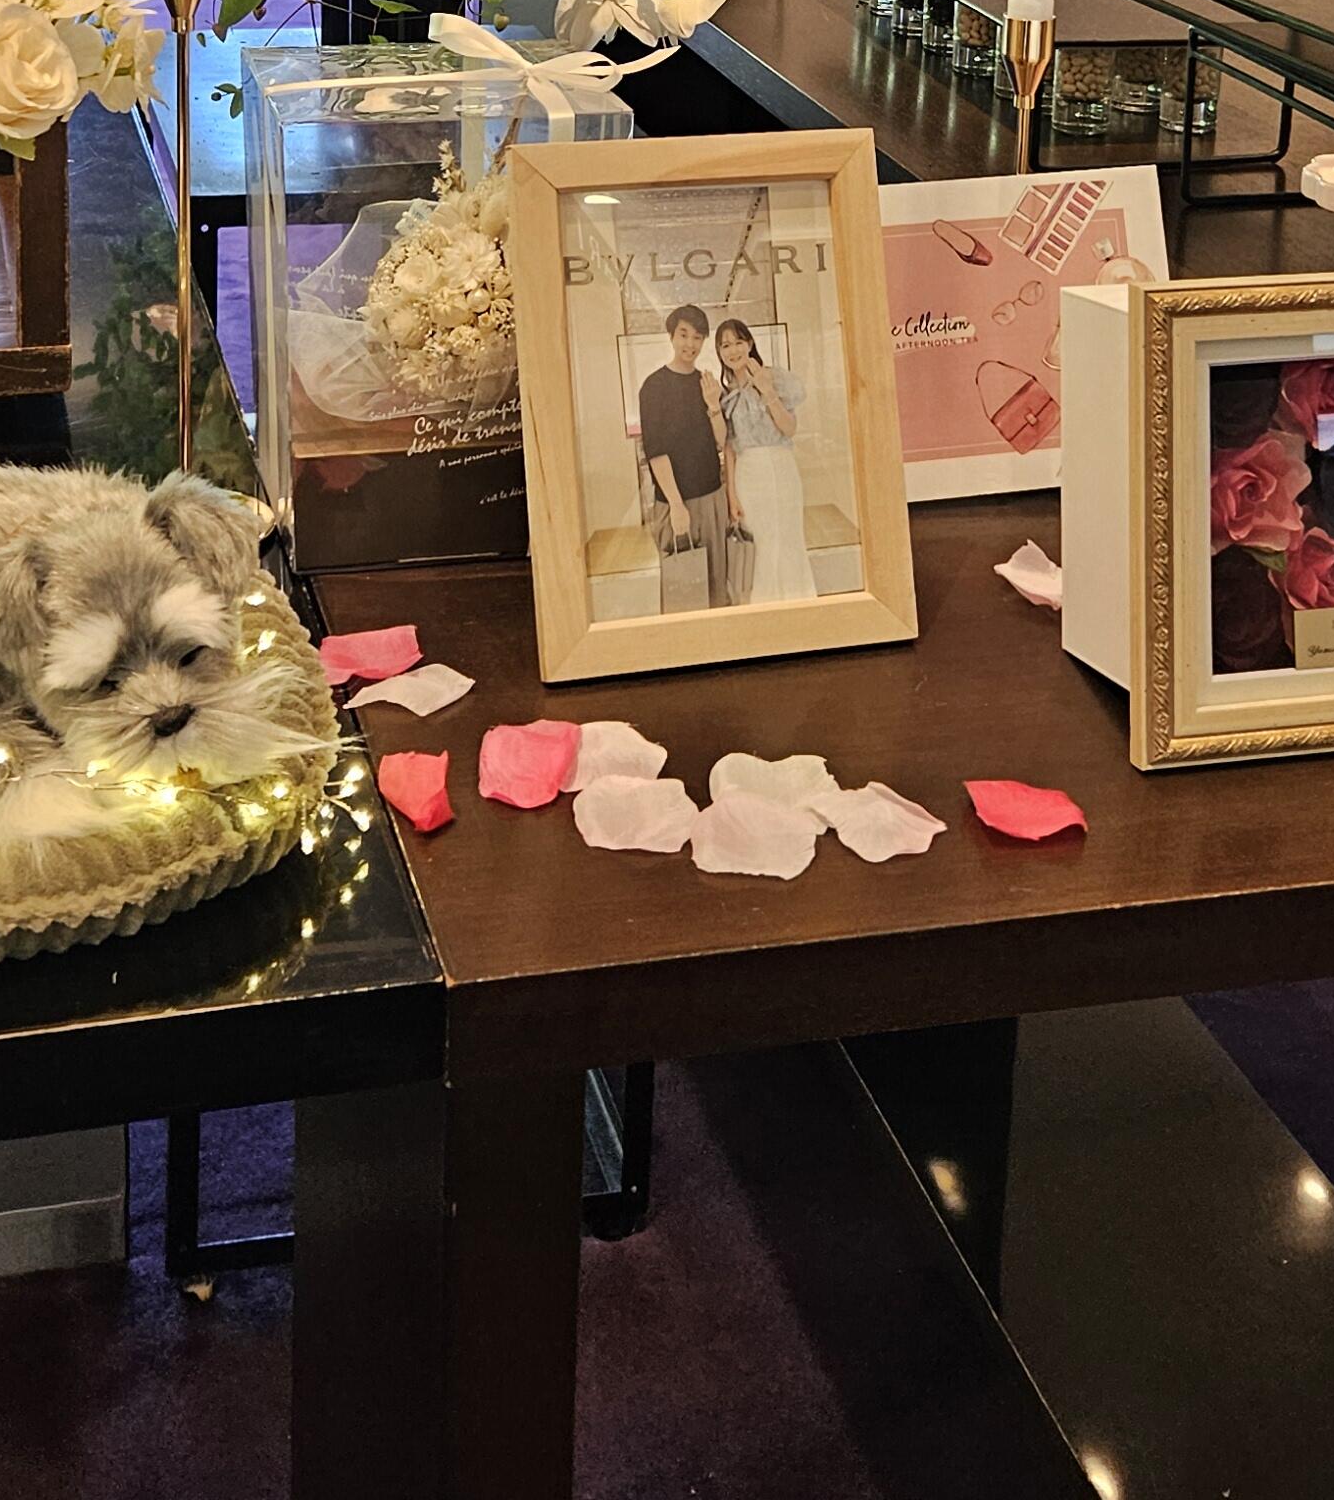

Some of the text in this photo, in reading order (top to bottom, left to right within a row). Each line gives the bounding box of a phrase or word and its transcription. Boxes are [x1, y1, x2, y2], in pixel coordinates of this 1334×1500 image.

[562, 242, 827, 287] BVLGARI
[904, 311, 970, 337] Collection
[895, 338, 956, 350] AFTERNOON
